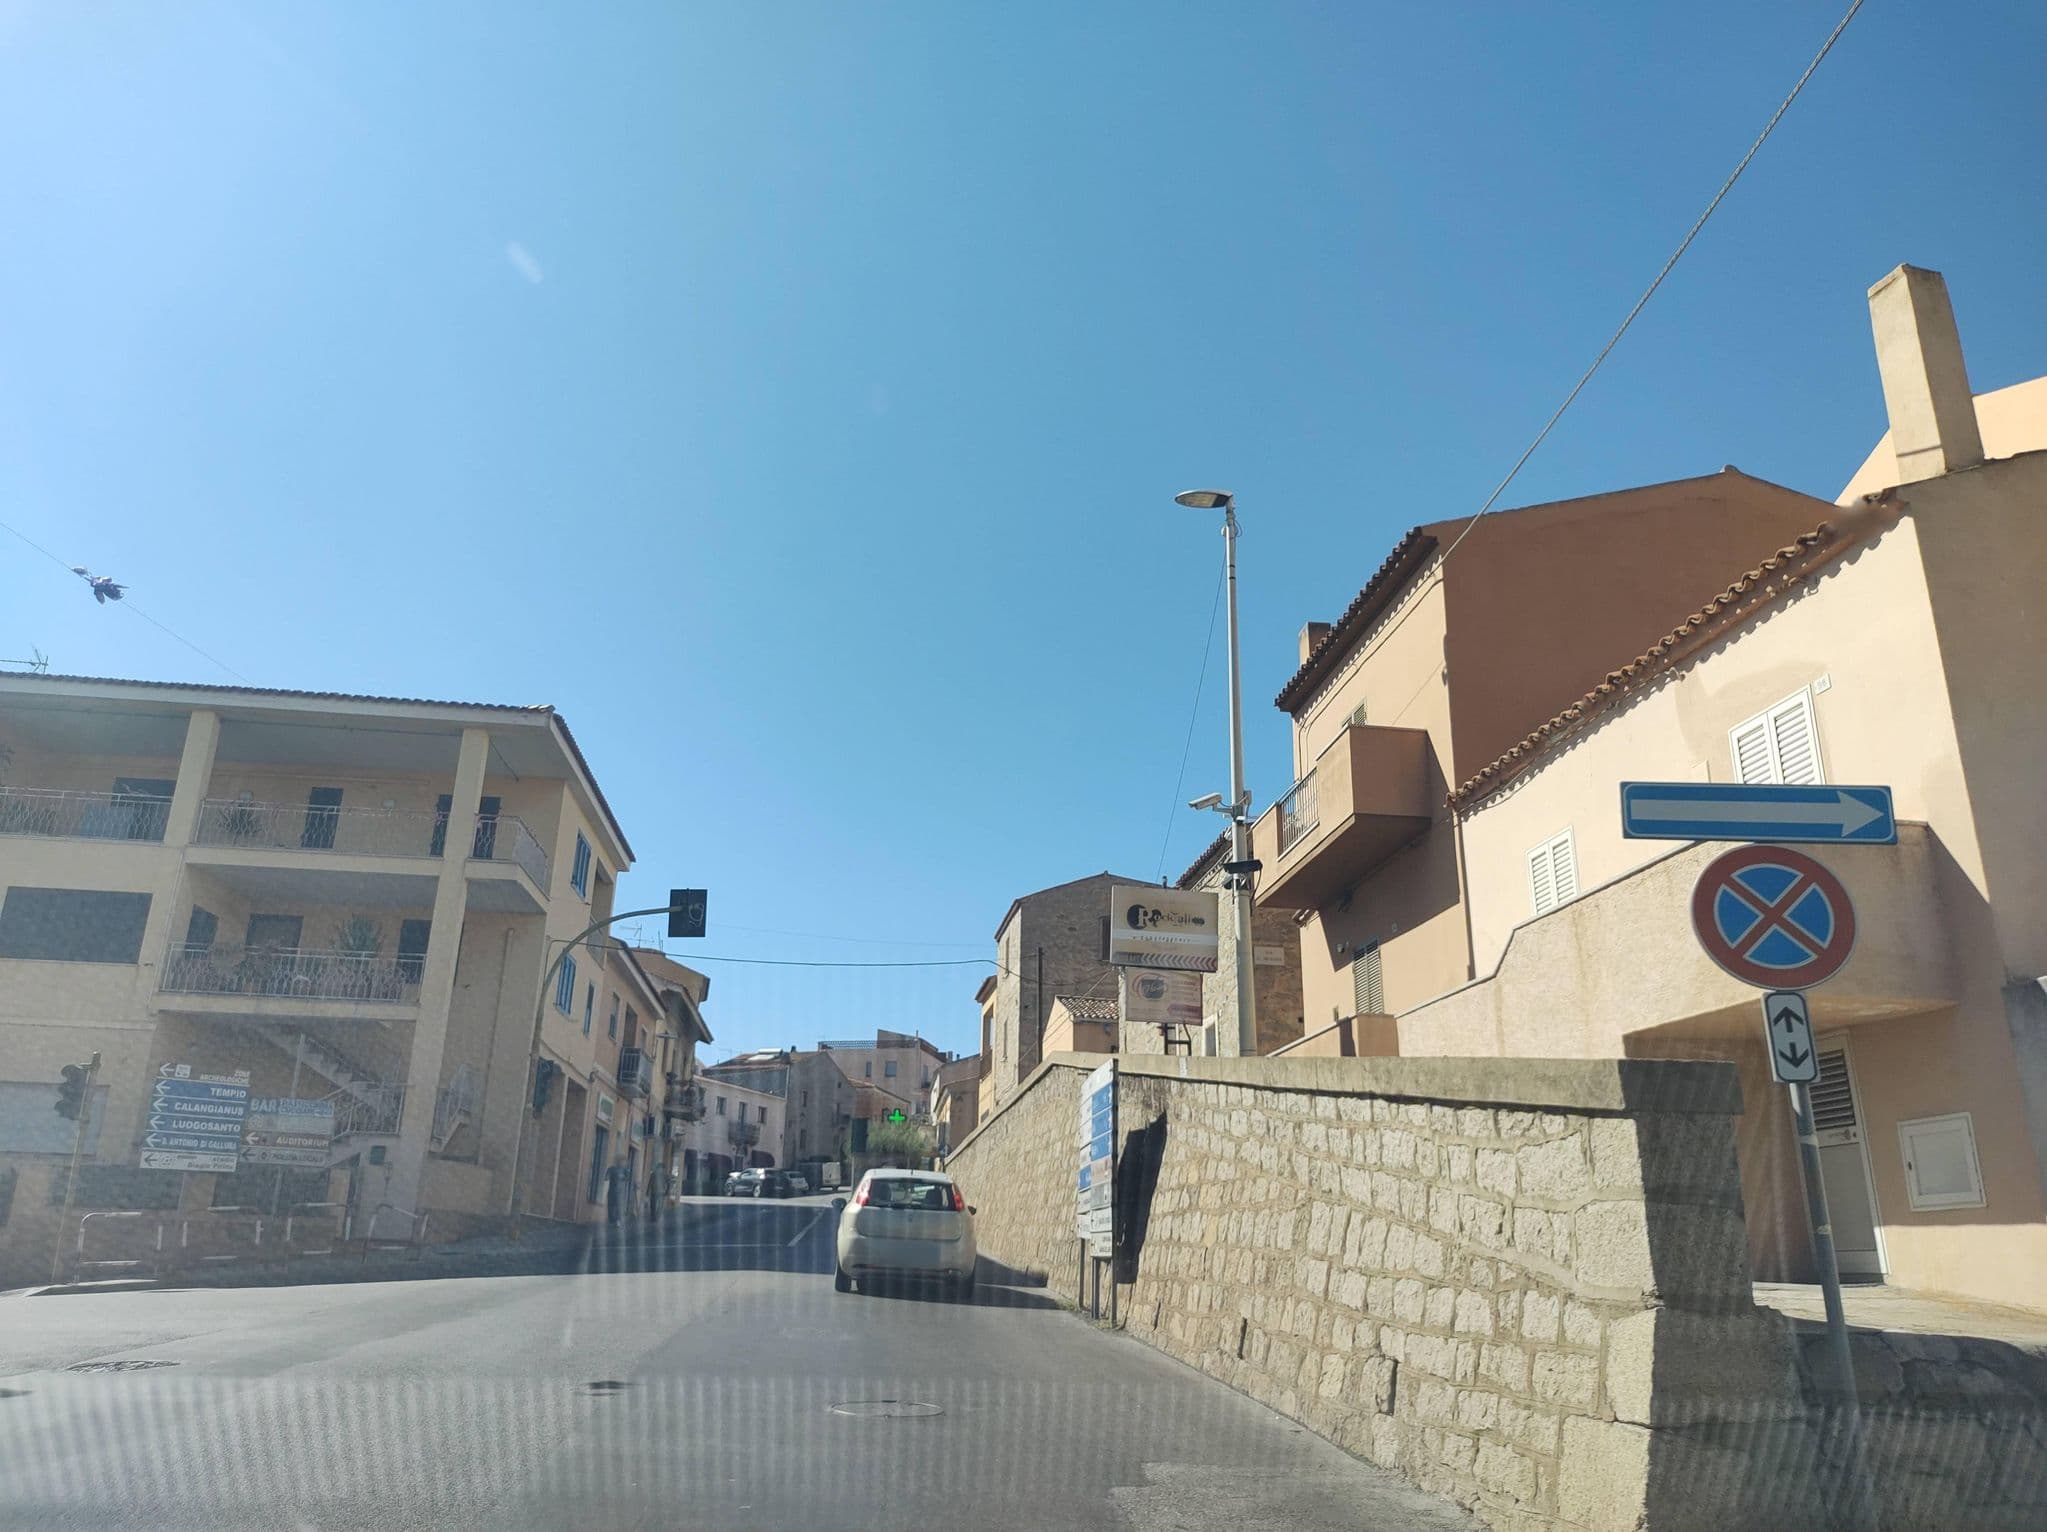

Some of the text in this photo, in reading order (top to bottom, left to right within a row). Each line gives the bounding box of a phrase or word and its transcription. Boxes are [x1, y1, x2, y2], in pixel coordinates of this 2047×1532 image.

[210, 1087, 247, 1098] TEMPIO
[174, 1102, 244, 1116] CALANGIANUS
[250, 1098, 277, 1113] BAR
[172, 1119, 241, 1132] LUOGOSANTO
[276, 1136, 330, 1147] AUDITORIUM
